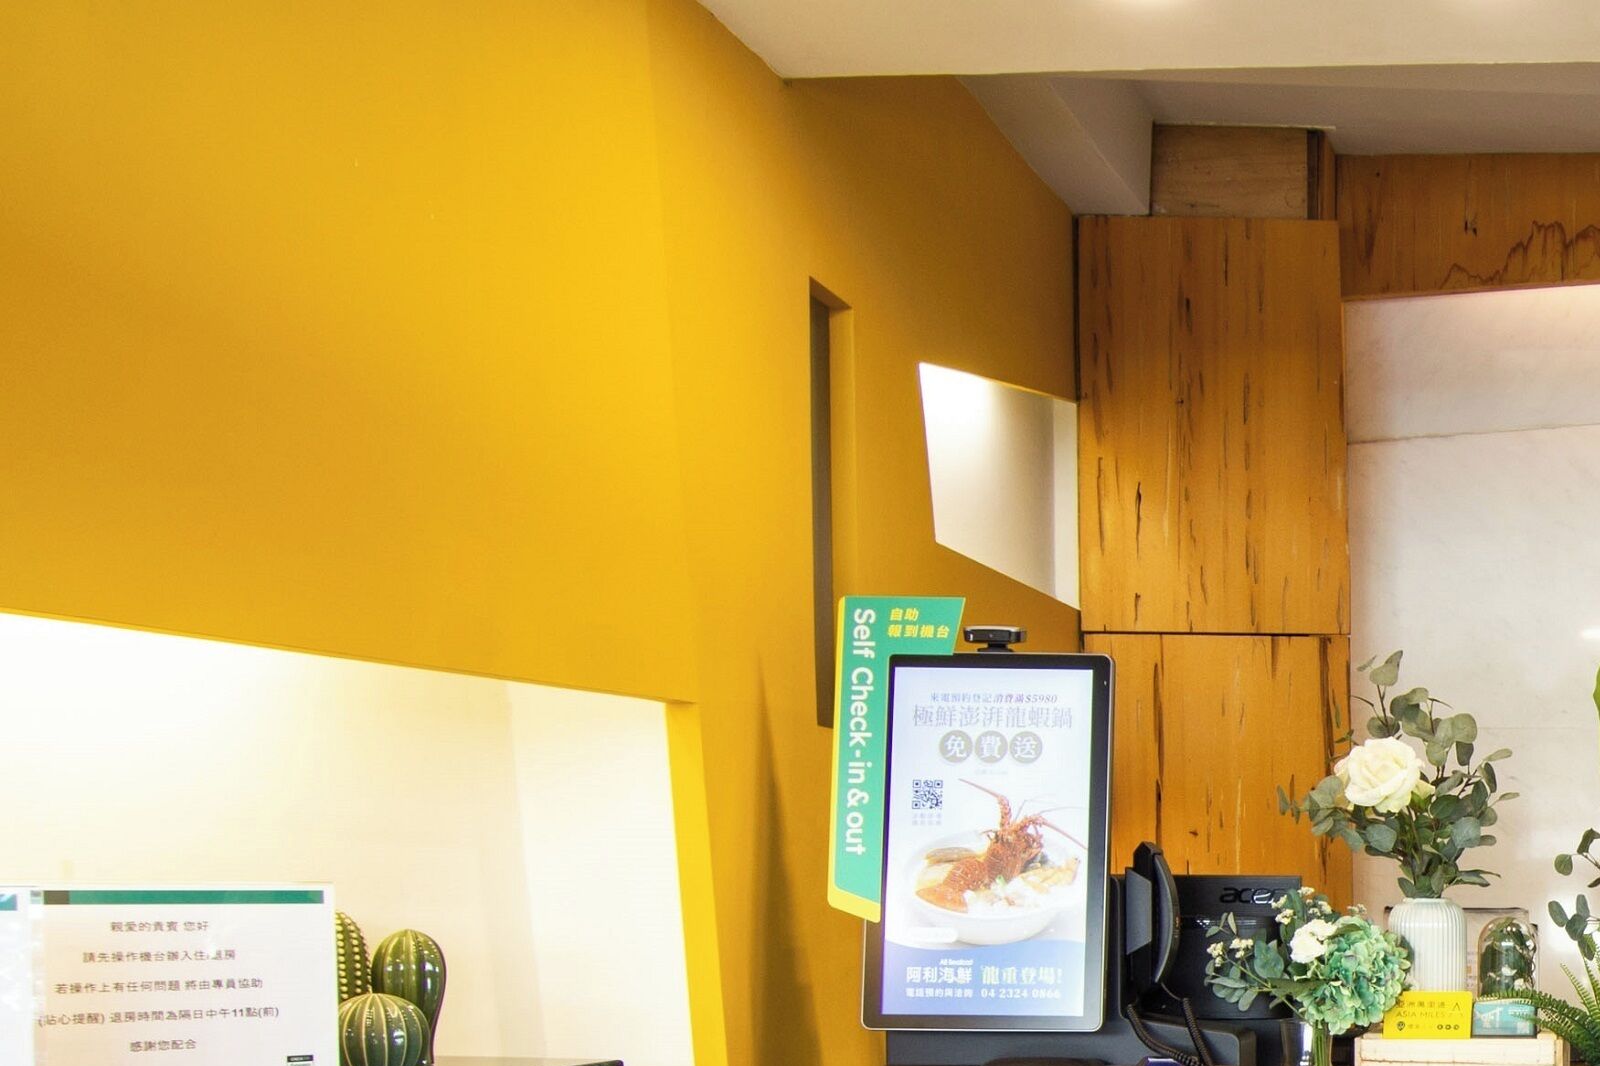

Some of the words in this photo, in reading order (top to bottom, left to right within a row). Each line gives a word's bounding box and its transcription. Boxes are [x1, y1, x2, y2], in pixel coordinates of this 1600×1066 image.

[889, 607, 919, 621] 自助
[853, 608, 876, 659] Self
[887, 624, 950, 638] 報到機台
[848, 666, 874, 784] Check-in
[913, 704, 1073, 728] 極鮮澎湃龍蝦鍋
[944, 735, 1038, 758] 免費送
[846, 787, 869, 807] &
[846, 811, 866, 855] out
[110, 921, 179, 933] 親愛的貴賓
[183, 920, 209, 932] 您好
[906, 966, 973, 984] 阿利海鮮
[55, 979, 181, 995] 若操作上有任何問題
[184, 977, 263, 990] 將由專員協助
[981, 988, 995, 999] 04
[999, 988, 1028, 999] 2324
[130, 1039, 197, 1052] 感謝您配合
